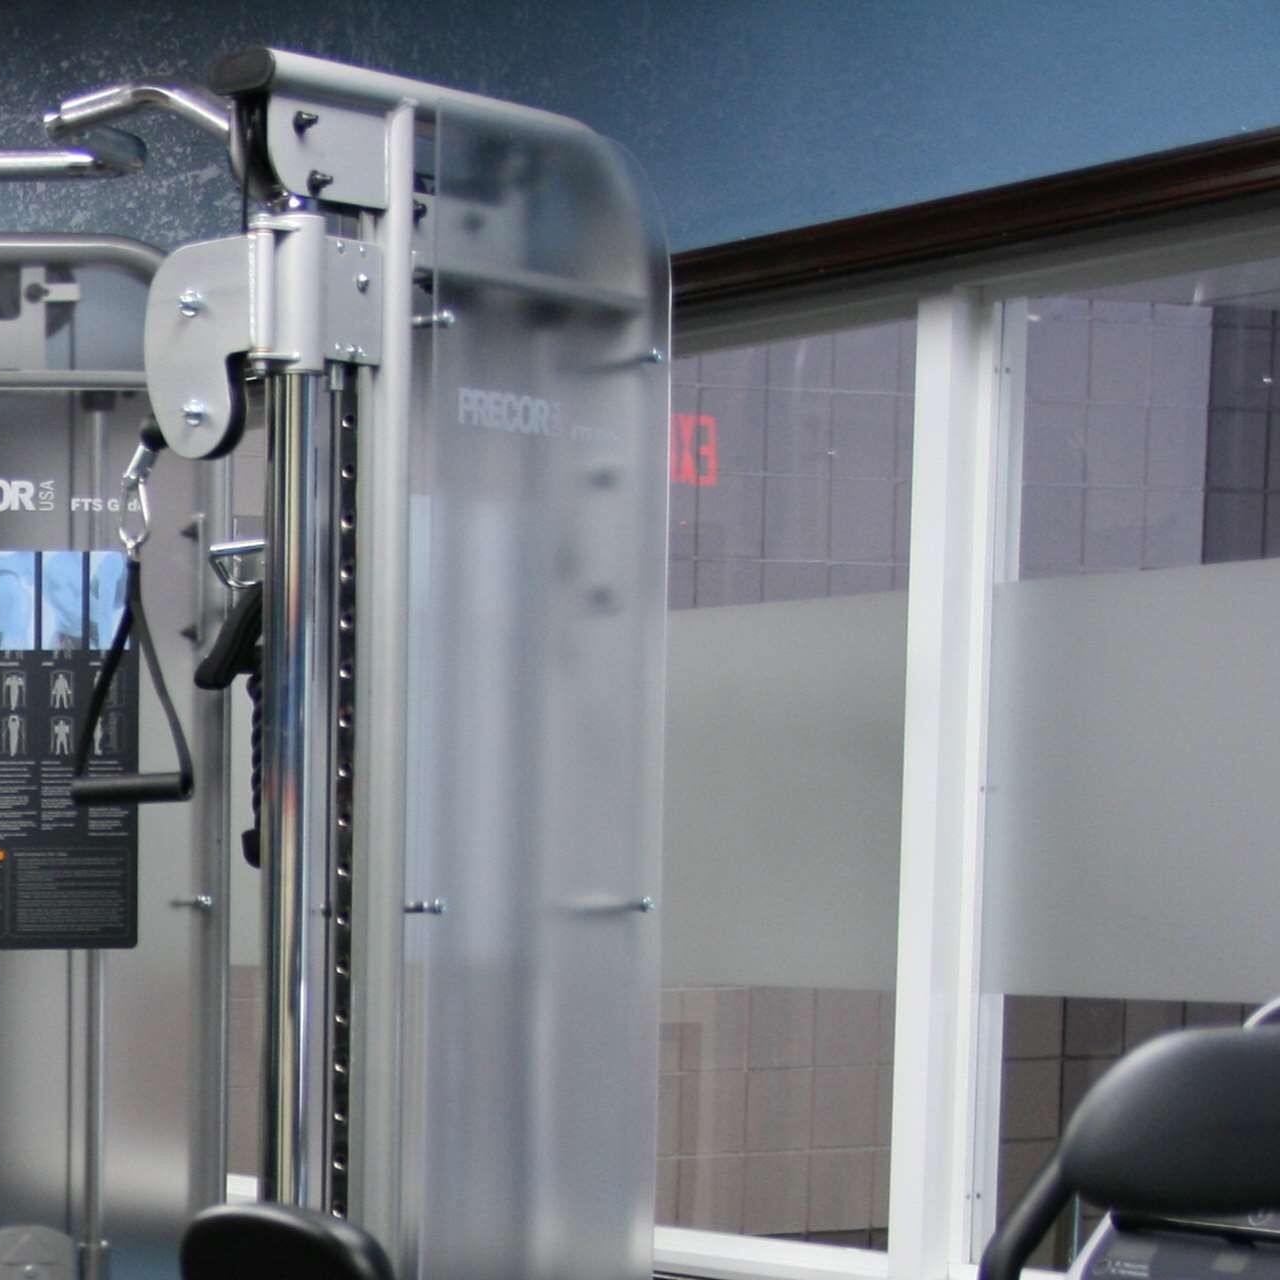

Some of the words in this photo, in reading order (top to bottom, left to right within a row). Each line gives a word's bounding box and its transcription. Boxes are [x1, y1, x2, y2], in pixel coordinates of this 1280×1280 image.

[458, 387, 549, 435] PRECOR
[39, 480, 55, 511] USA
[71, 498, 102, 511] FTS
